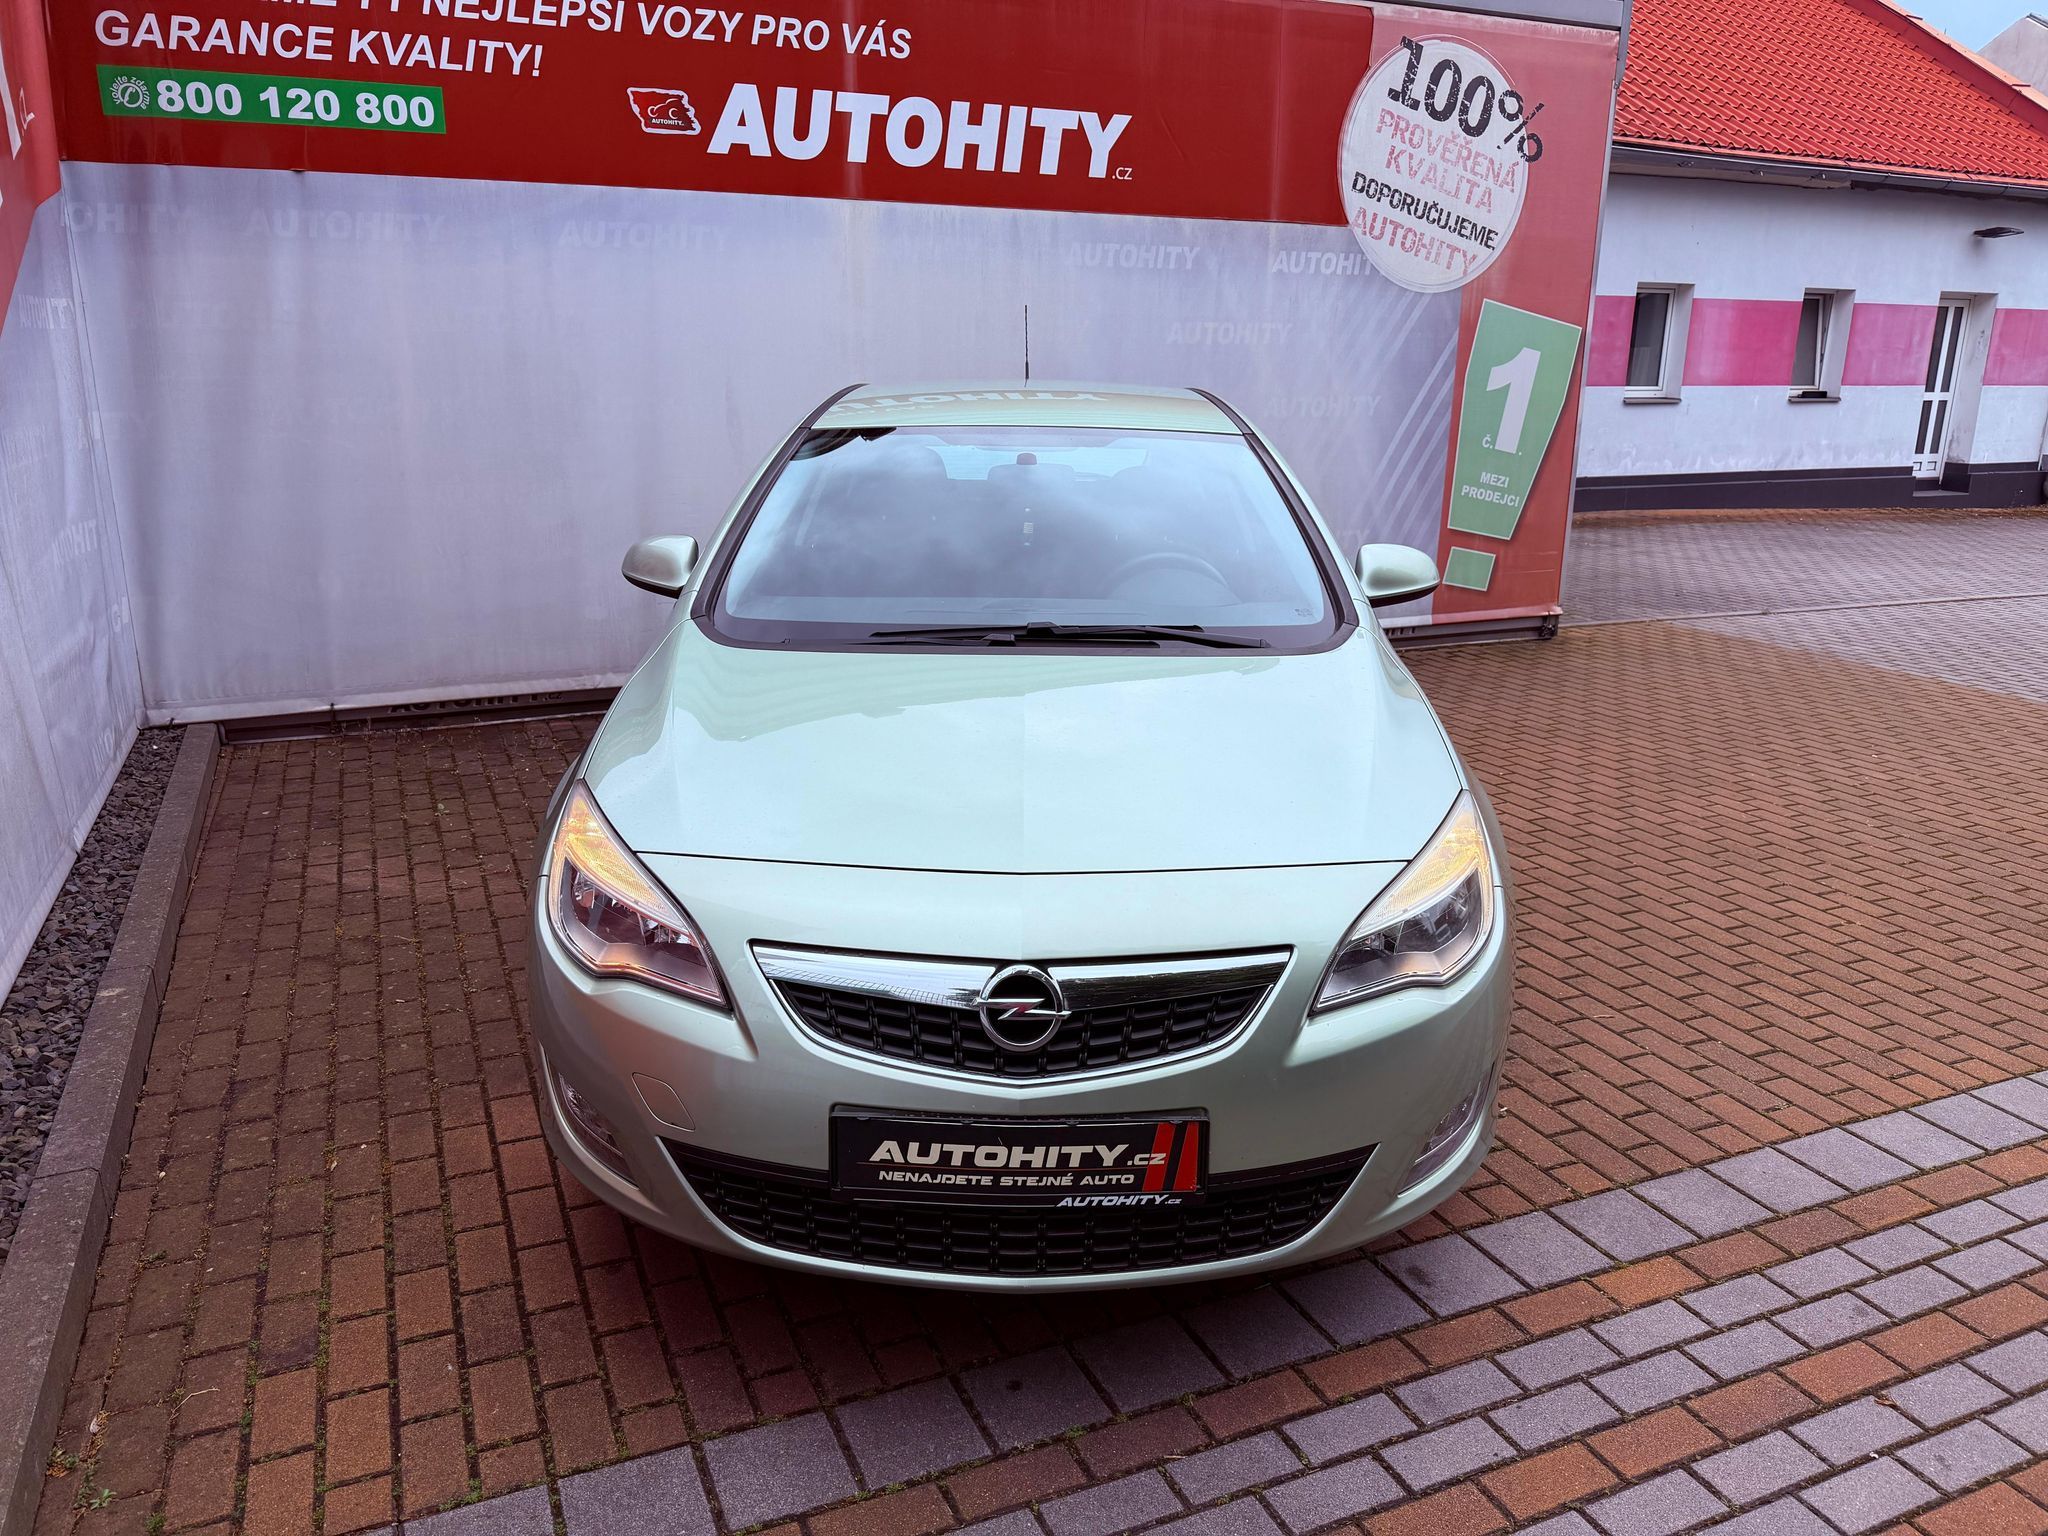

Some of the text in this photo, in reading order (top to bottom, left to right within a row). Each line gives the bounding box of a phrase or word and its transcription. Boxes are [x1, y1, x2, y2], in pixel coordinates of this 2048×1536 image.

[95, 9, 544, 77] GARANCE KVALITY!
[637, 3, 744, 43] VOZY
[750, 17, 831, 52] PRO
[841, 20, 912, 59] VÁS
[156, 79, 435, 127] 800 120 800
[1387, 35, 1545, 164] 100%
[1375, 107, 1520, 194] PROVĚŘENÁ
[1384, 144, 1493, 213] KVALITA
[1351, 171, 1499, 251] DOPORUČUJEME
[1064, 243, 1200, 270] AUTOHITY
[1271, 249, 1376, 276] AUTOHIT
[1351, 206, 1479, 276] AUTOHITY
[1166, 321, 1292, 345] AUTOHITY
[1461, 485, 1520, 507] PRODEJCI
[1480, 471, 1510, 488] MEZI
[878, 1171, 1135, 1186] NENAJDETE STEJNÉ AUTO
